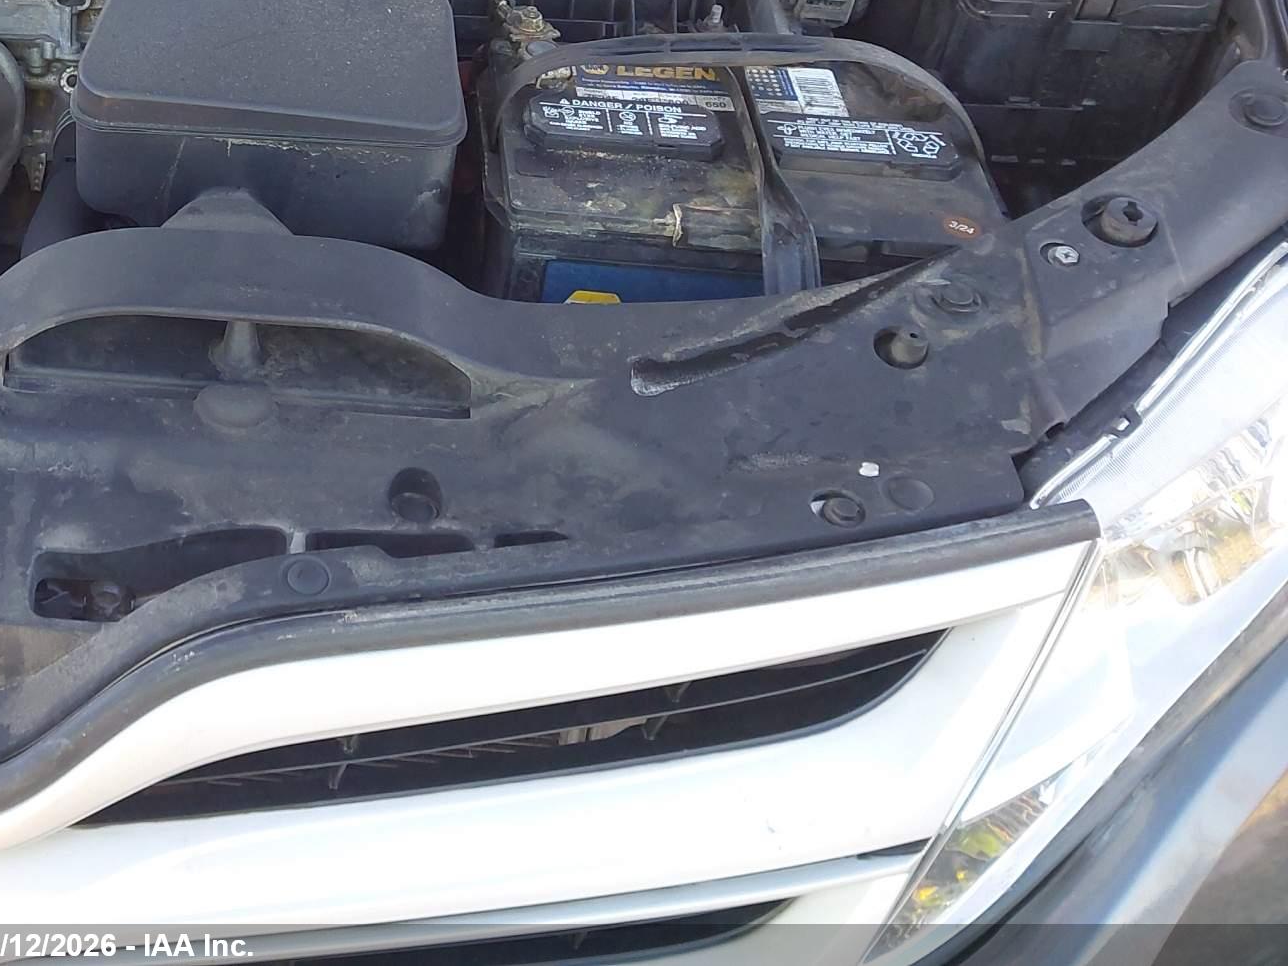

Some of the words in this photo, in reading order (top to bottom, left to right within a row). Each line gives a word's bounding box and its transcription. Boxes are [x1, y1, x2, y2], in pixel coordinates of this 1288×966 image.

[616, 65, 717, 82] LEGEN
[572, 99, 623, 110] DANGER
[635, 103, 682, 113] POISON
[948, 220, 975, 235] 3/24
